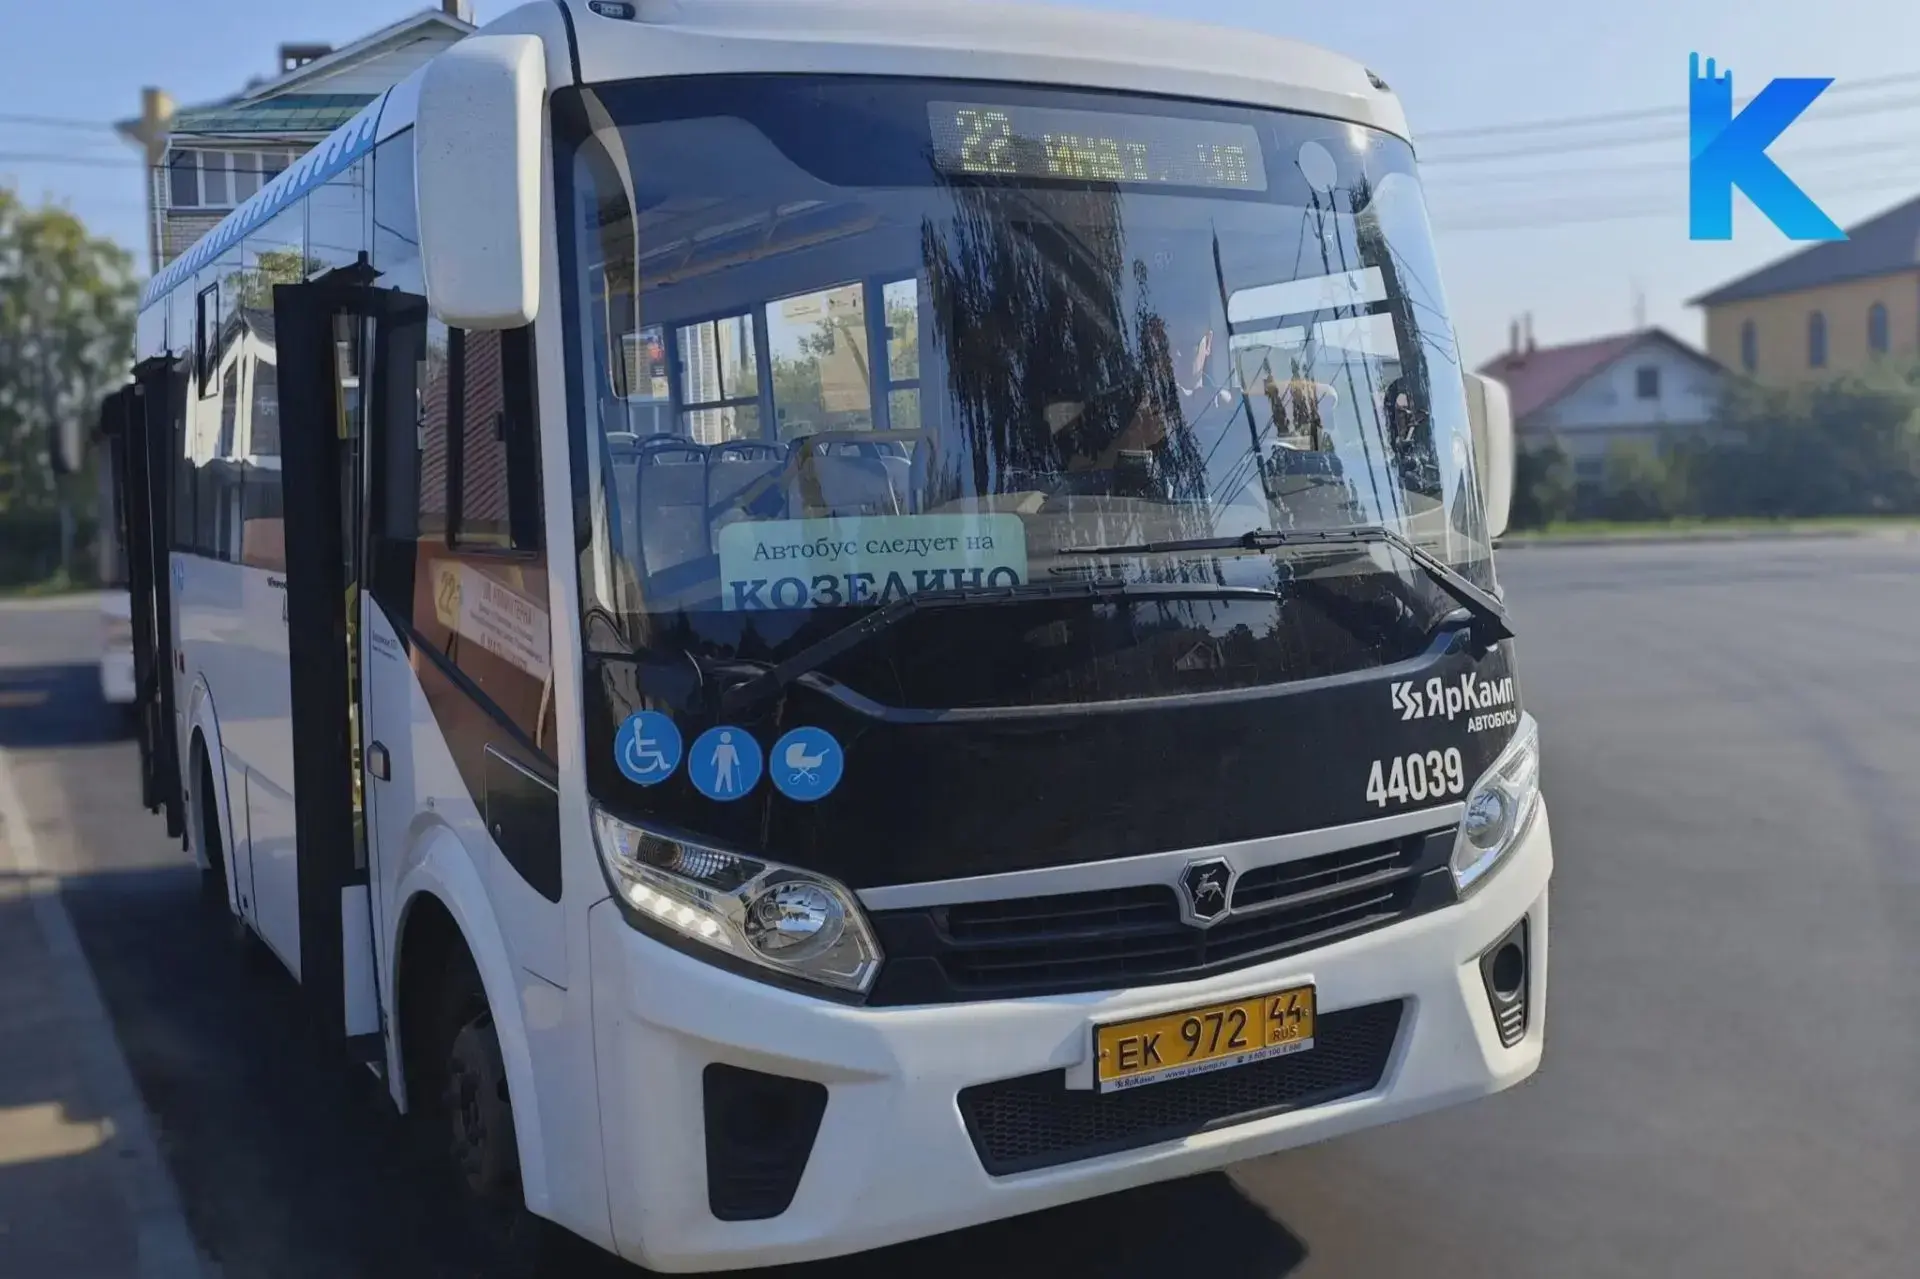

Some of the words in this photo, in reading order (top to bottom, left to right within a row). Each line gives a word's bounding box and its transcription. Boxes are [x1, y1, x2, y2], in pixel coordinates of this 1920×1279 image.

[957, 110, 1016, 172] 22
[753, 536, 857, 561] Автобус
[865, 536, 959, 557] следует
[965, 537, 994, 551] на
[729, 566, 1020, 610] КОЗЕЛИНО
[1426, 672, 1515, 720] ЯрКамп
[1366, 747, 1465, 808] 44039
[1181, 1007, 1248, 1057] 972
[1269, 994, 1301, 1026] 44
[1272, 1025, 1298, 1041] RUS
